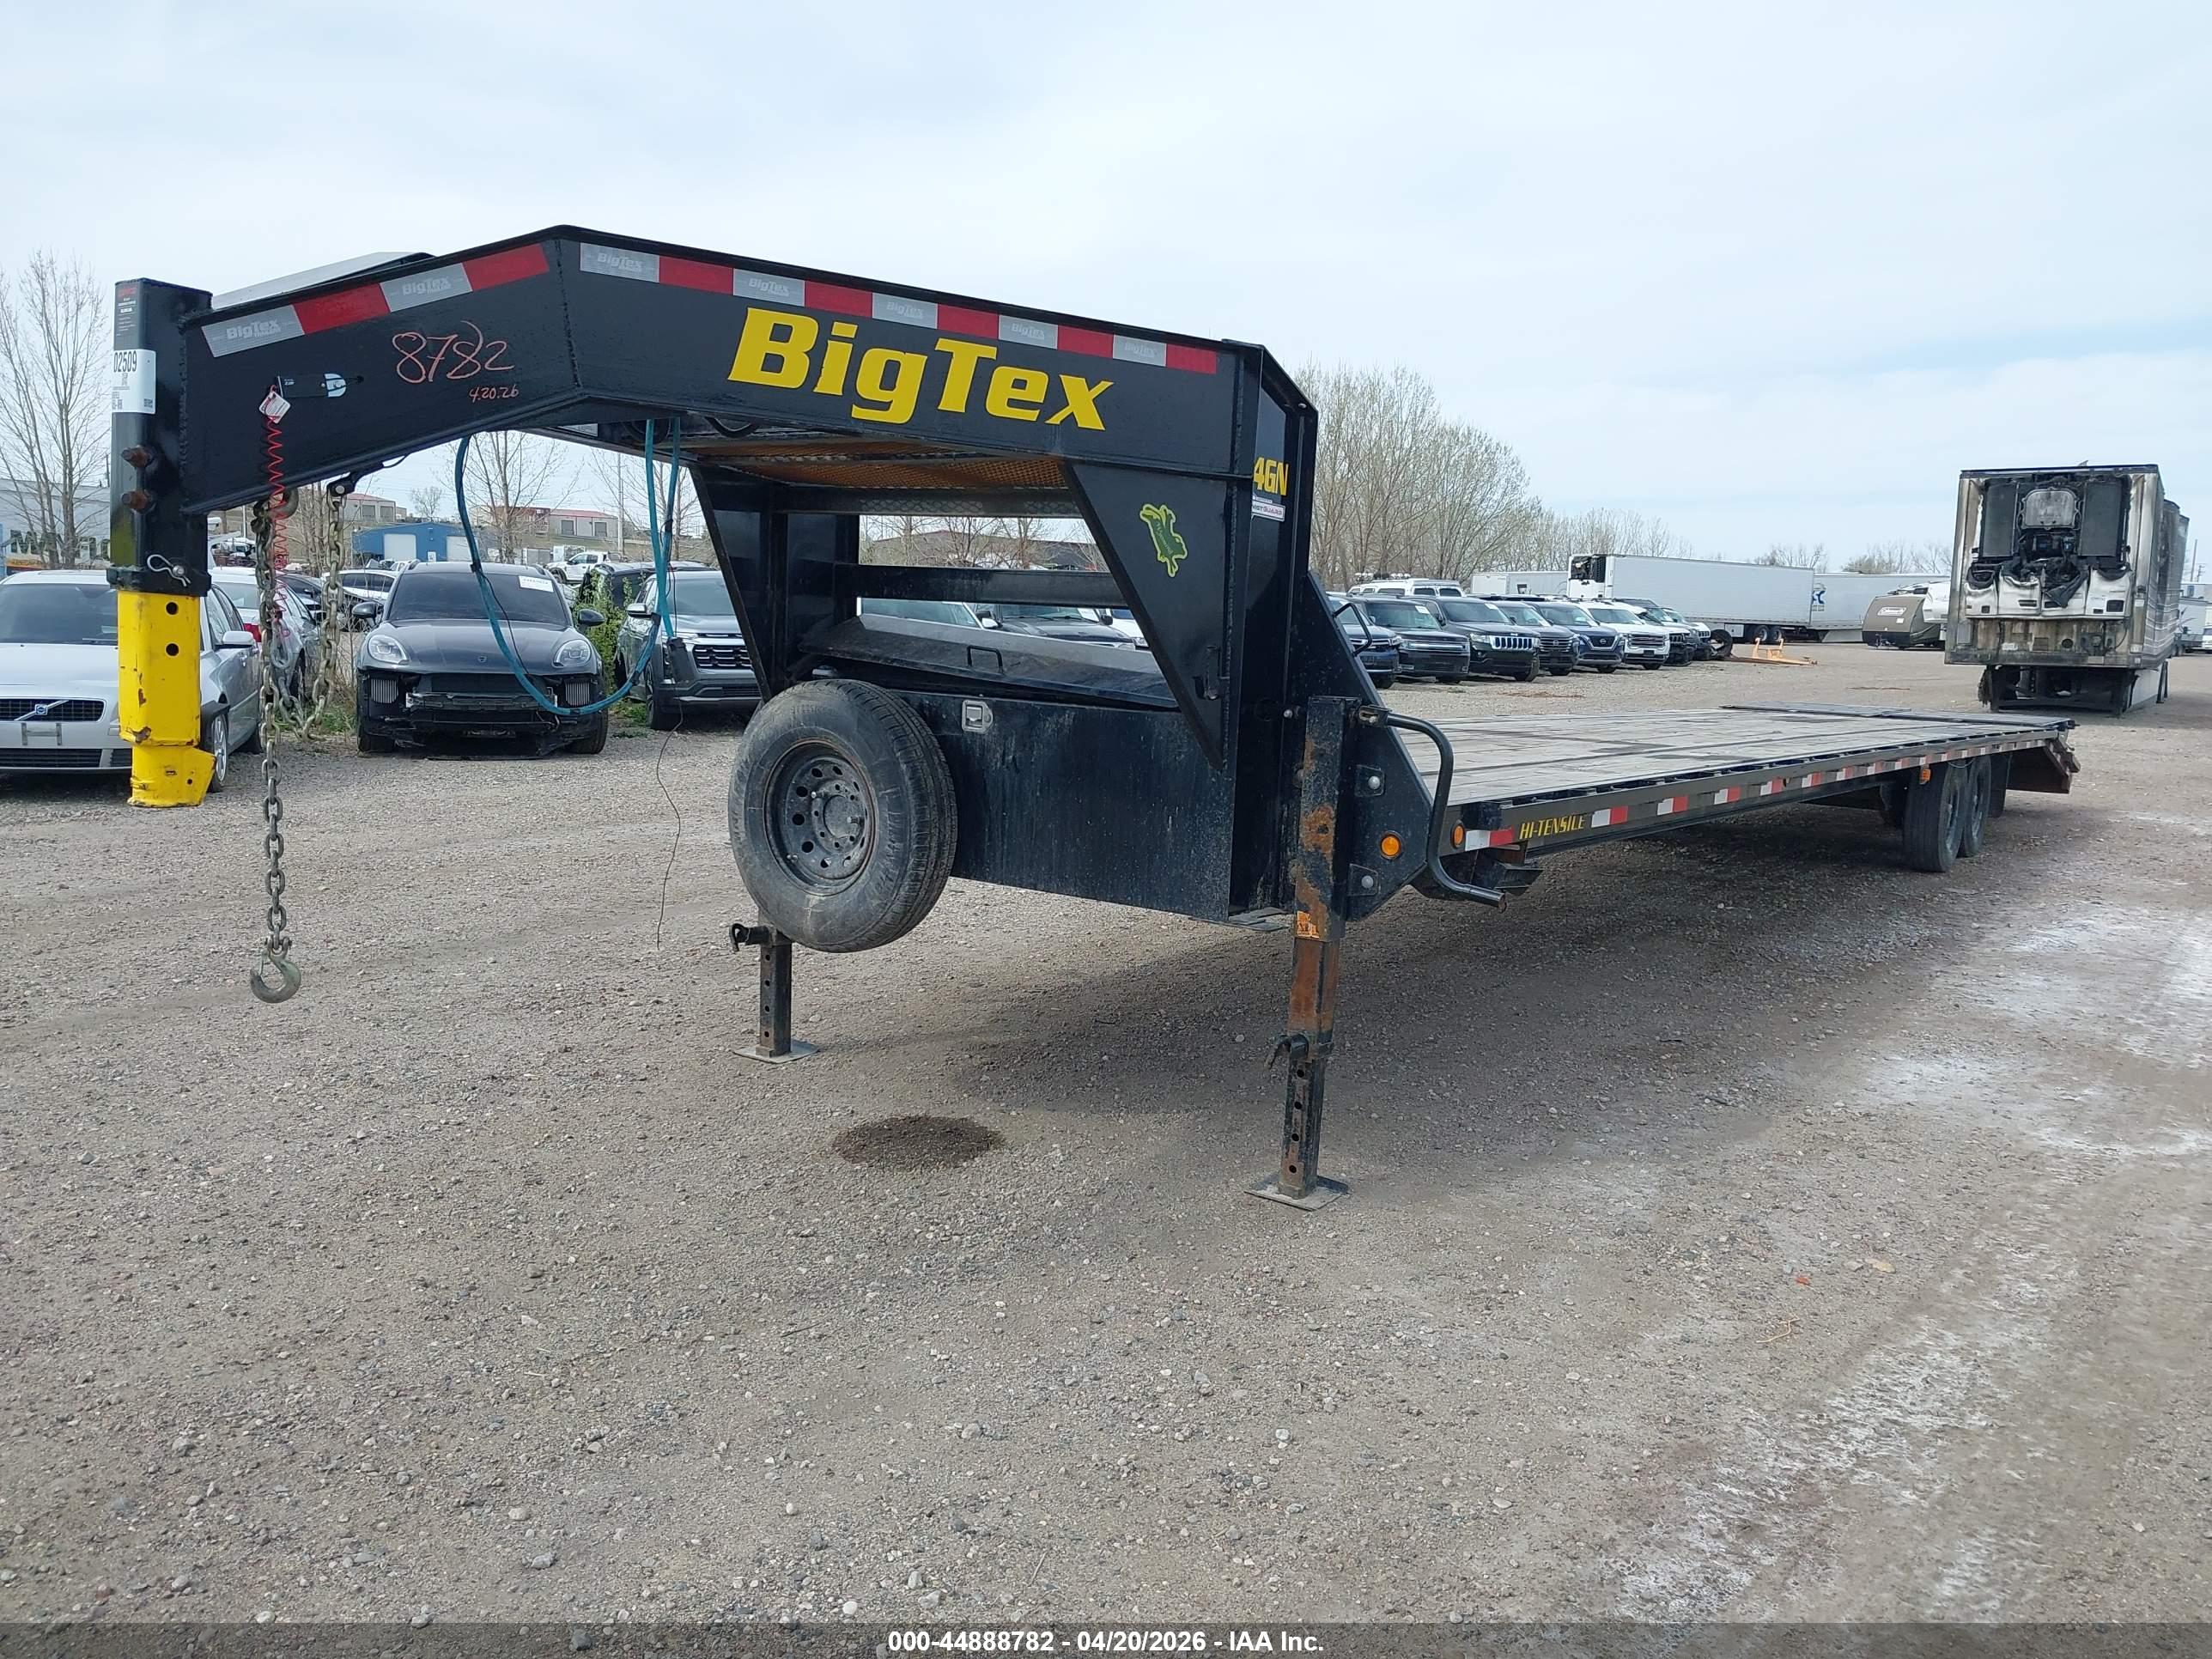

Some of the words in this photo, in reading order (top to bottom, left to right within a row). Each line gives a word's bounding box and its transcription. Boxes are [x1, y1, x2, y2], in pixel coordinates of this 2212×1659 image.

[226, 319, 279, 339] BigTex
[392, 320, 515, 383] 8782
[728, 307, 1115, 431] BigTex
[1519, 816, 1586, 839] HI-TENSILE
